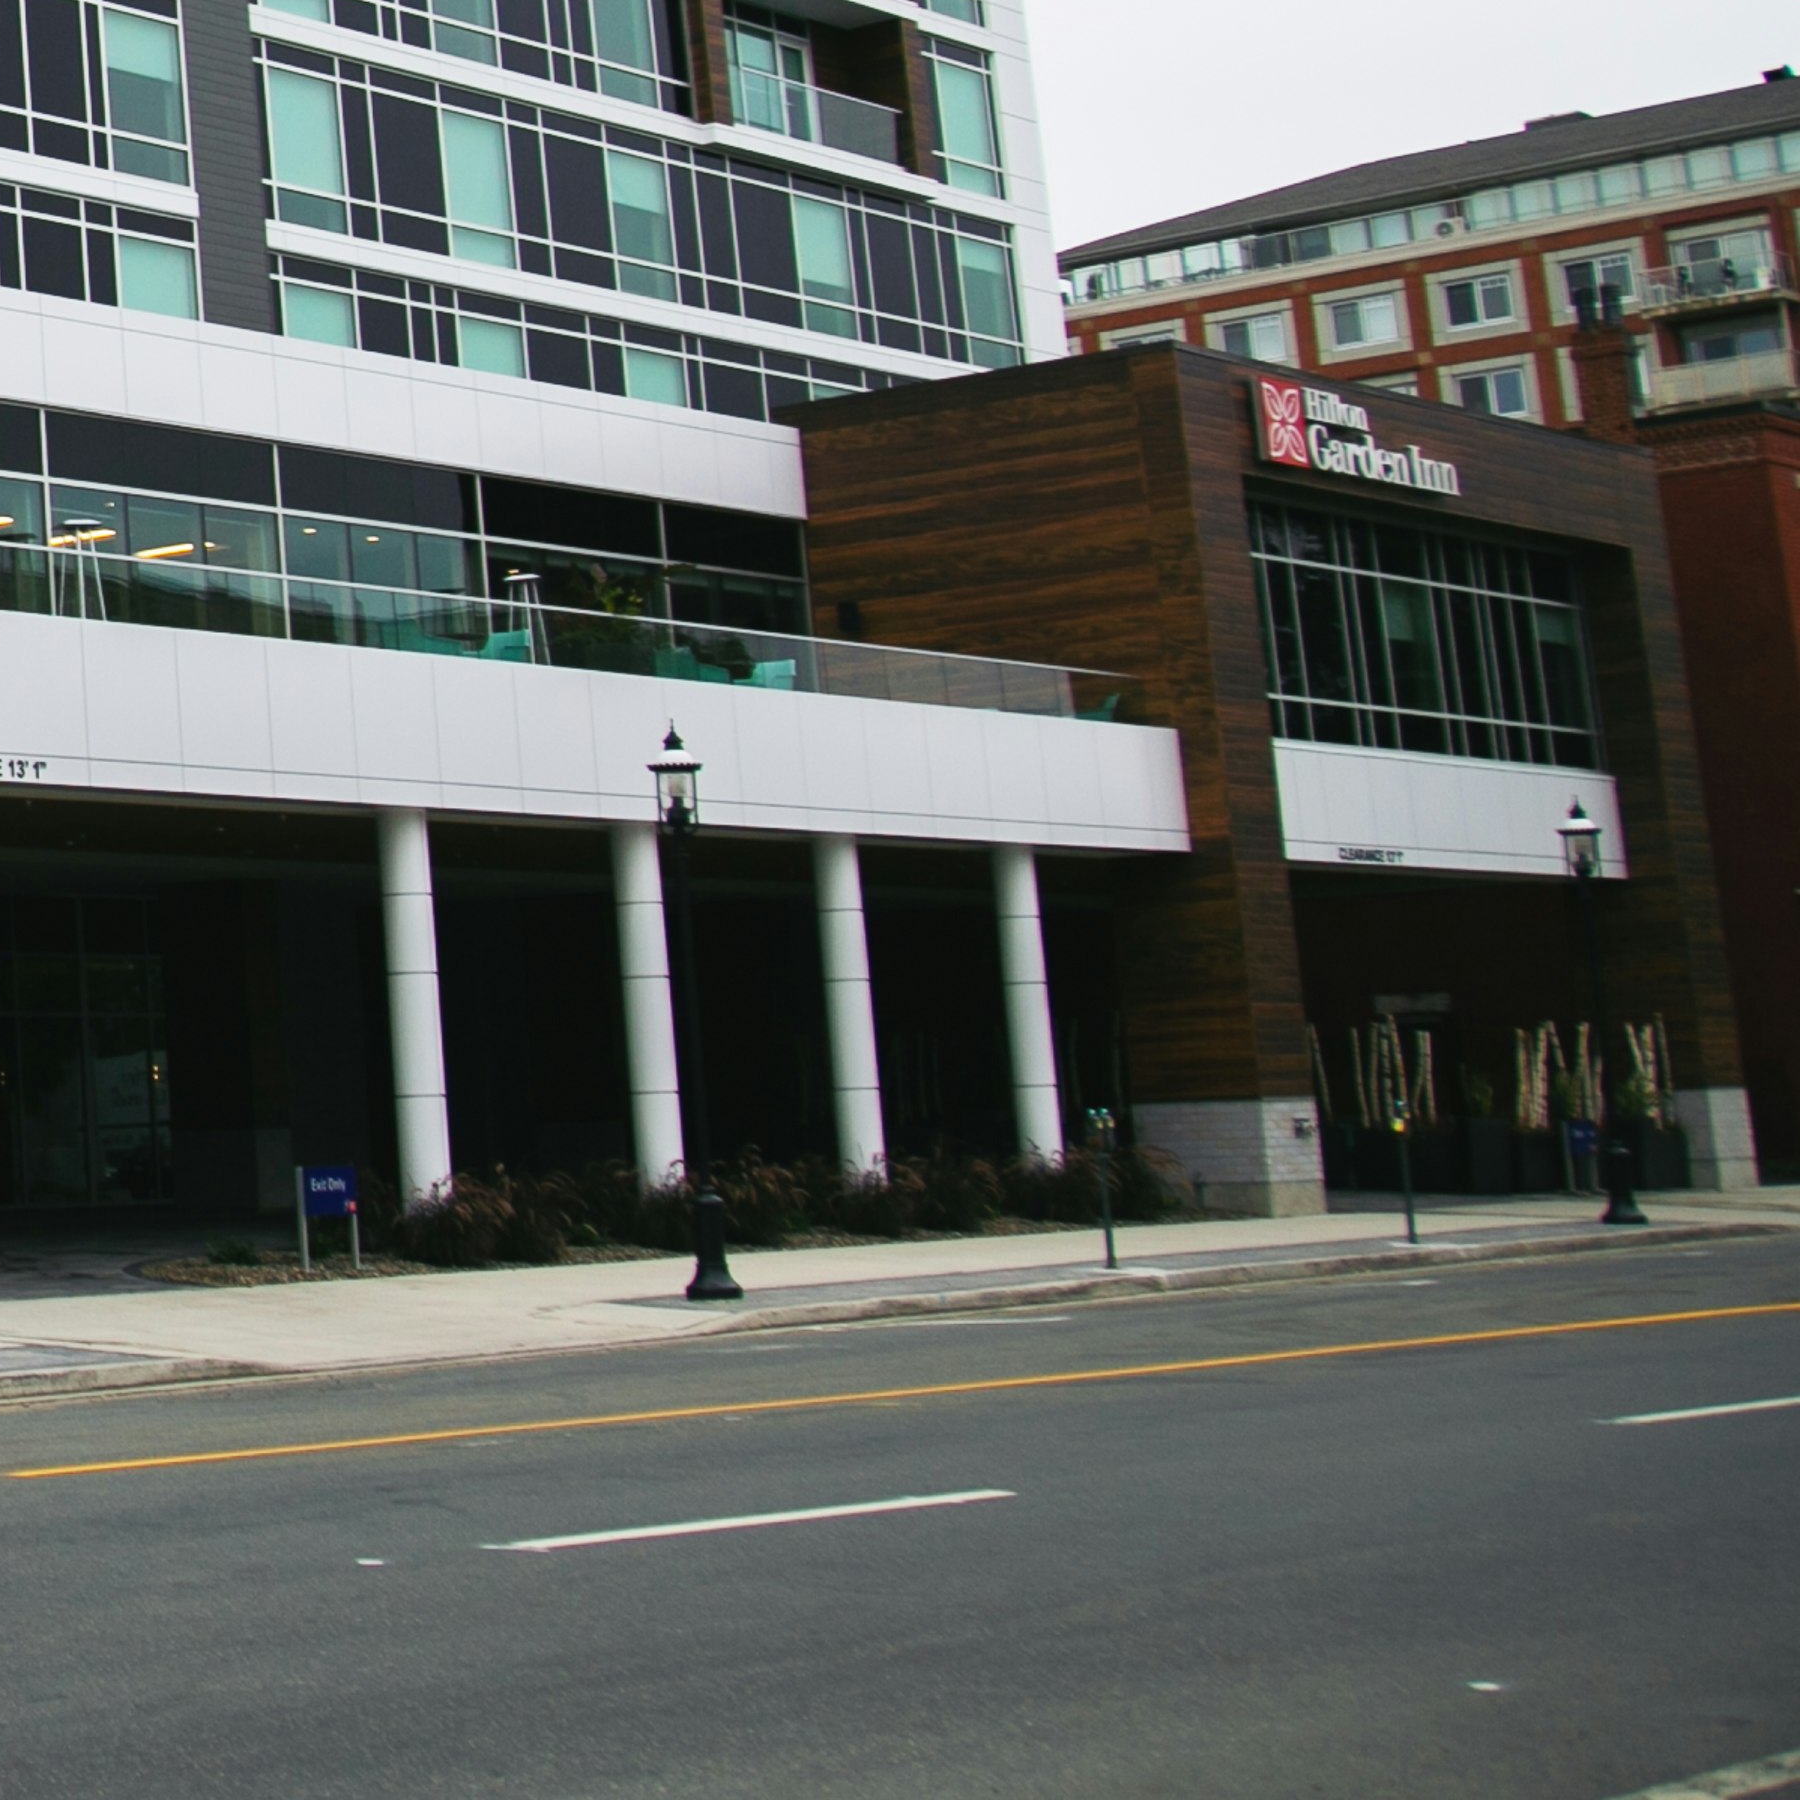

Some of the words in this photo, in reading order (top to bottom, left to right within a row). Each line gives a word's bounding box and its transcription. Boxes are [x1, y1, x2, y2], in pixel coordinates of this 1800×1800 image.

[1301, 386, 1372, 433] Hilton
[1307, 423, 1413, 488] Garden
[1405, 444, 1462, 497] Inn
[7, 758, 30, 780] 13'
[310, 1177, 327, 1192] Exit
[328, 1177, 346, 1192] Only
